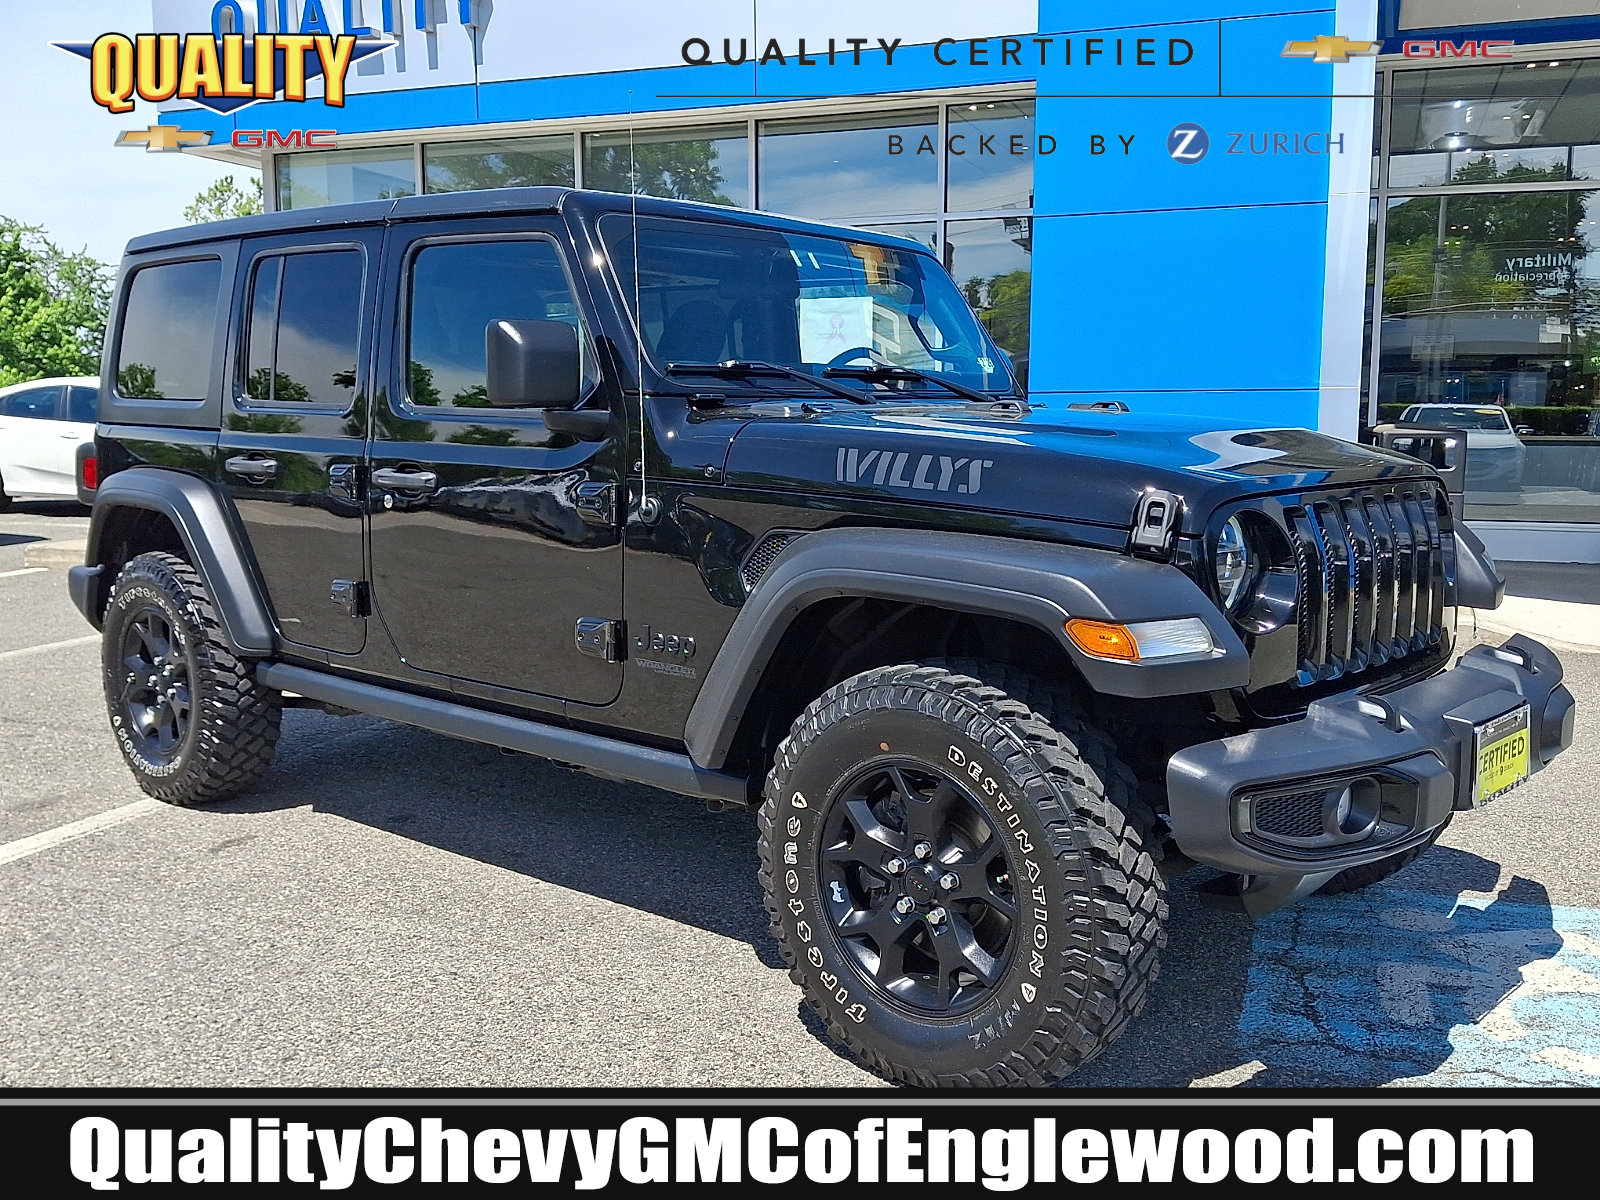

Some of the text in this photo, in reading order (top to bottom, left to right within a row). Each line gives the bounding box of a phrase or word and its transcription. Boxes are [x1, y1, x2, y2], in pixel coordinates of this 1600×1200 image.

[836, 447, 994, 494] WILLYS
[633, 623, 697, 662] Jeep
[634, 657, 696, 676] WRANGLER
[948, 745, 1050, 980] DESTINATION
[784, 815, 868, 1024] Firestone
